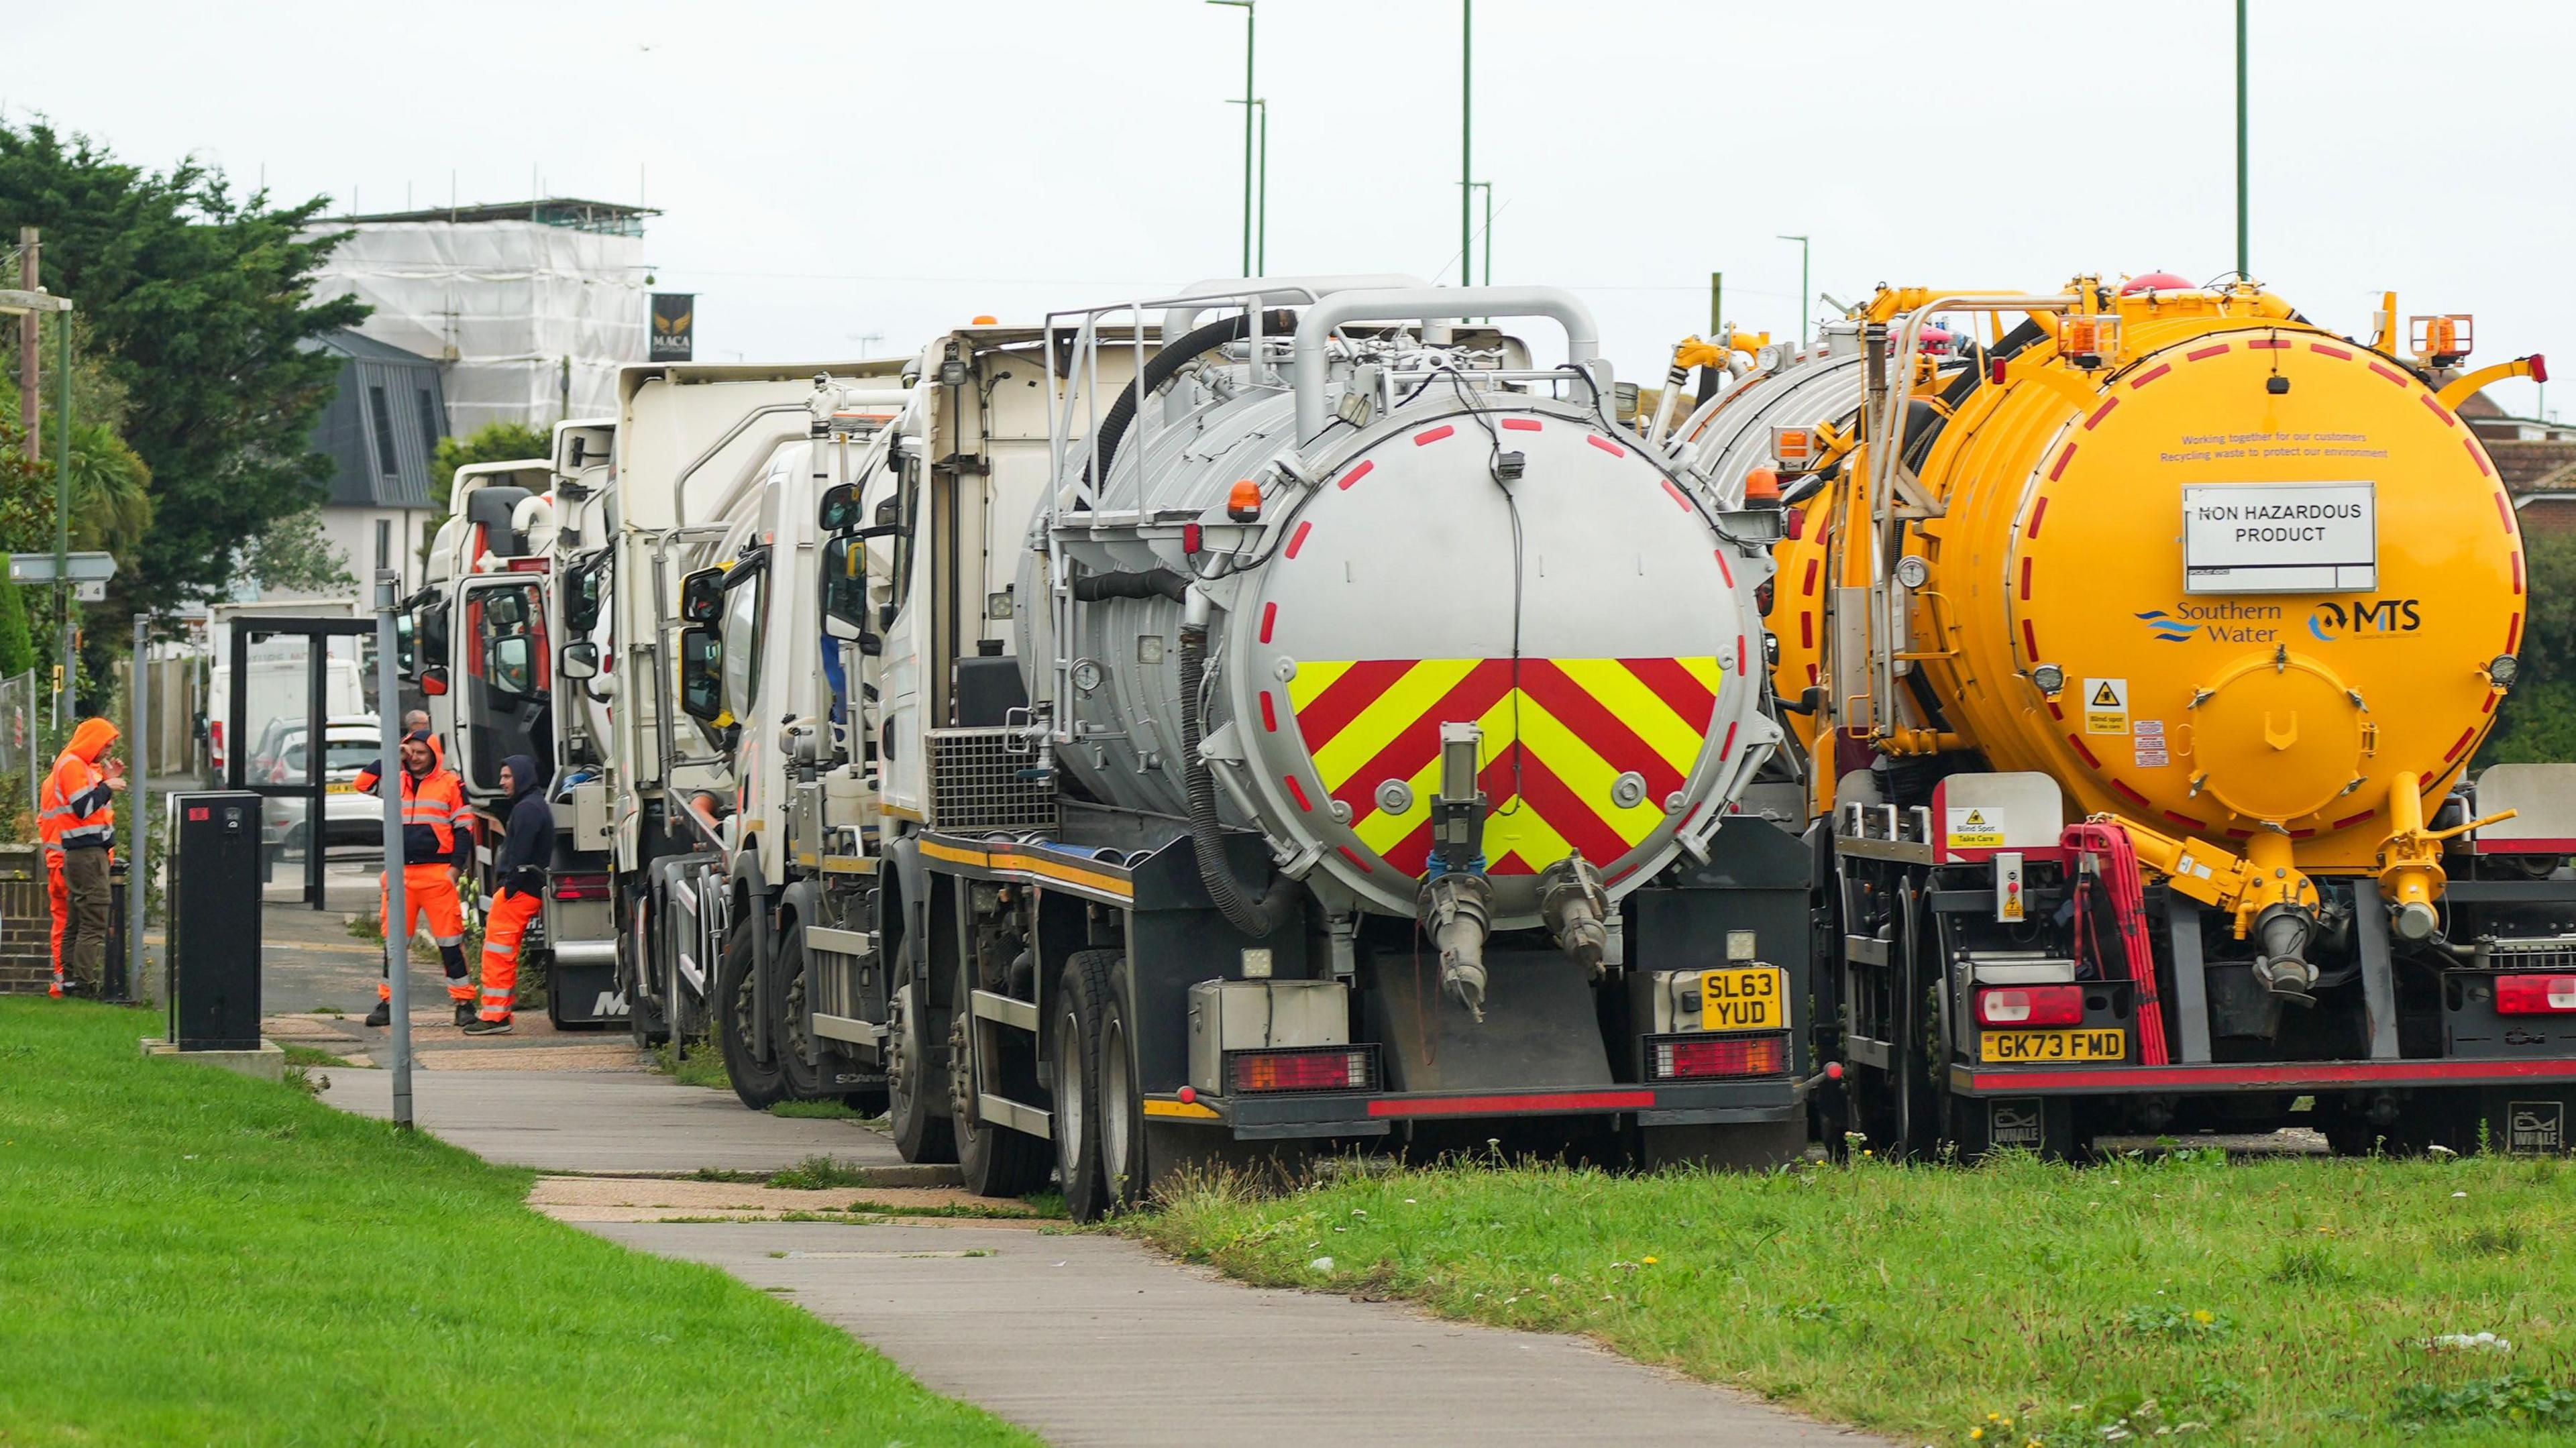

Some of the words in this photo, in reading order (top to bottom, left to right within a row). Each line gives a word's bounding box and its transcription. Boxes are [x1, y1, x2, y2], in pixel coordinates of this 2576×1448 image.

[654, 335, 690, 345] MACA
[2182, 435, 2225, 445] Working
[2229, 433, 2271, 443] together
[2276, 432, 2289, 441] for
[2314, 433, 2367, 441] customers
[2160, 451, 2210, 462] Recycling
[2214, 449, 2244, 457] waste
[2249, 449, 2259, 457] to
[2263, 448, 2300, 457] protect
[2324, 448, 2387, 457] environment
[2200, 506, 2237, 520] NON
[2245, 504, 2361, 519] HAZARDOUS
[2236, 527, 2326, 542] PRODUCT
[2177, 601, 2281, 620] Southern
[2353, 600, 2420, 632] MTS
[2208, 625, 2278, 642] Water
[1708, 974, 1772, 998] SL63
[1717, 1001, 1765, 1024] YUD
[1998, 1034, 2063, 1057] GK73
[2071, 1034, 2119, 1056] FMD
[1996, 1128, 2038, 1141] WHALE
[2514, 1131, 2557, 1145] WHALE
